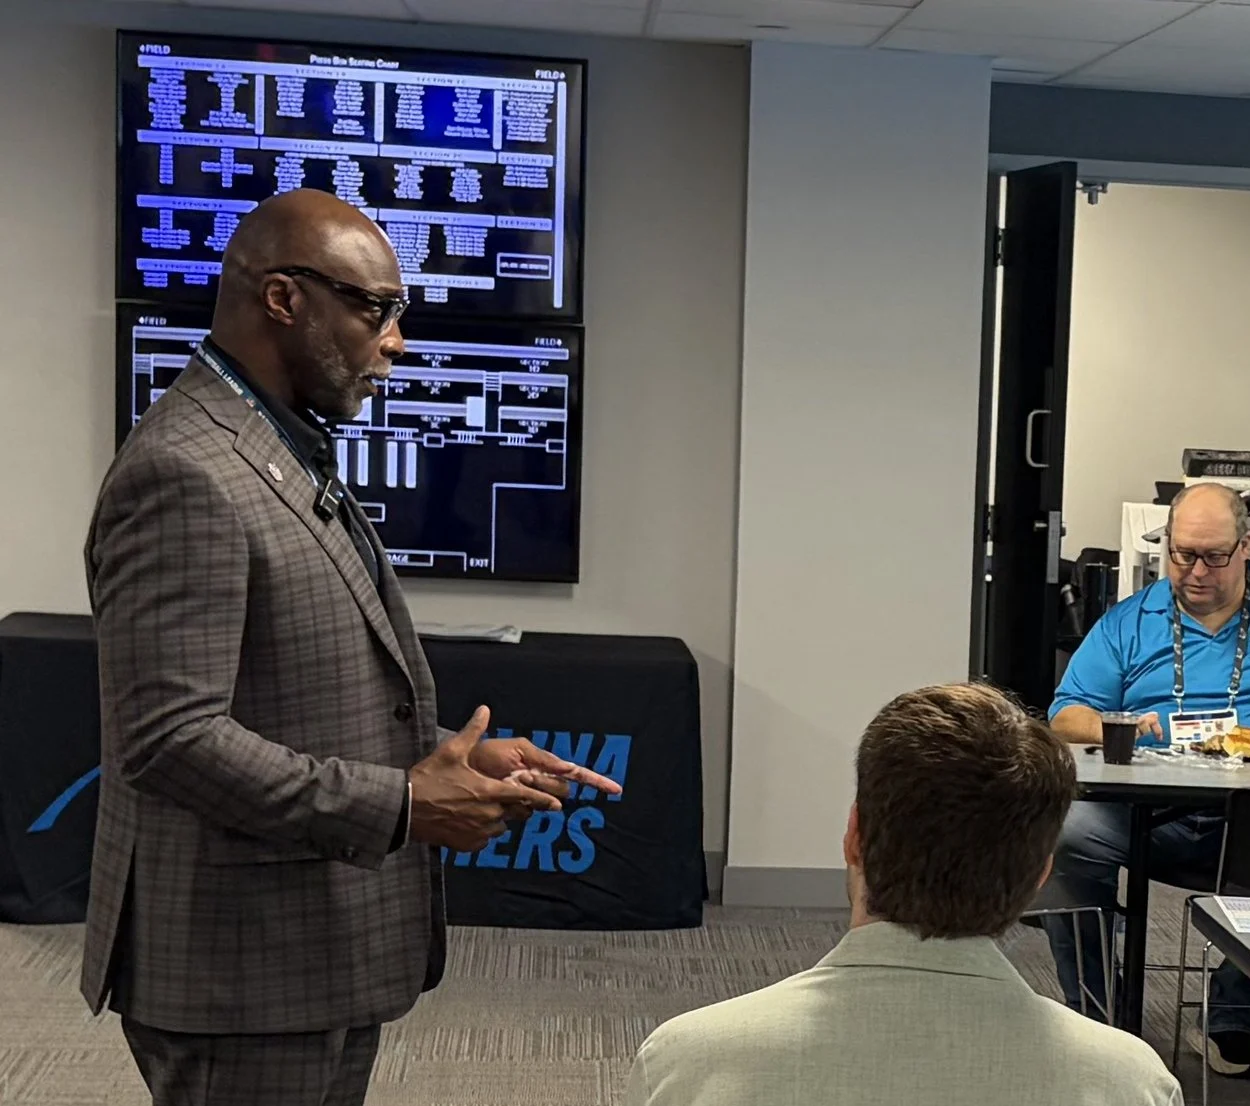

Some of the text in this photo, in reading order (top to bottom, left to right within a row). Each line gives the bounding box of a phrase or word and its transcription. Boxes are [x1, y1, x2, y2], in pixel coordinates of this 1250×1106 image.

[535, 69, 559, 79] FIELD
[144, 317, 167, 325] FIELD
[534, 337, 556, 346] FIELD
[469, 557, 489, 568] EXIT
